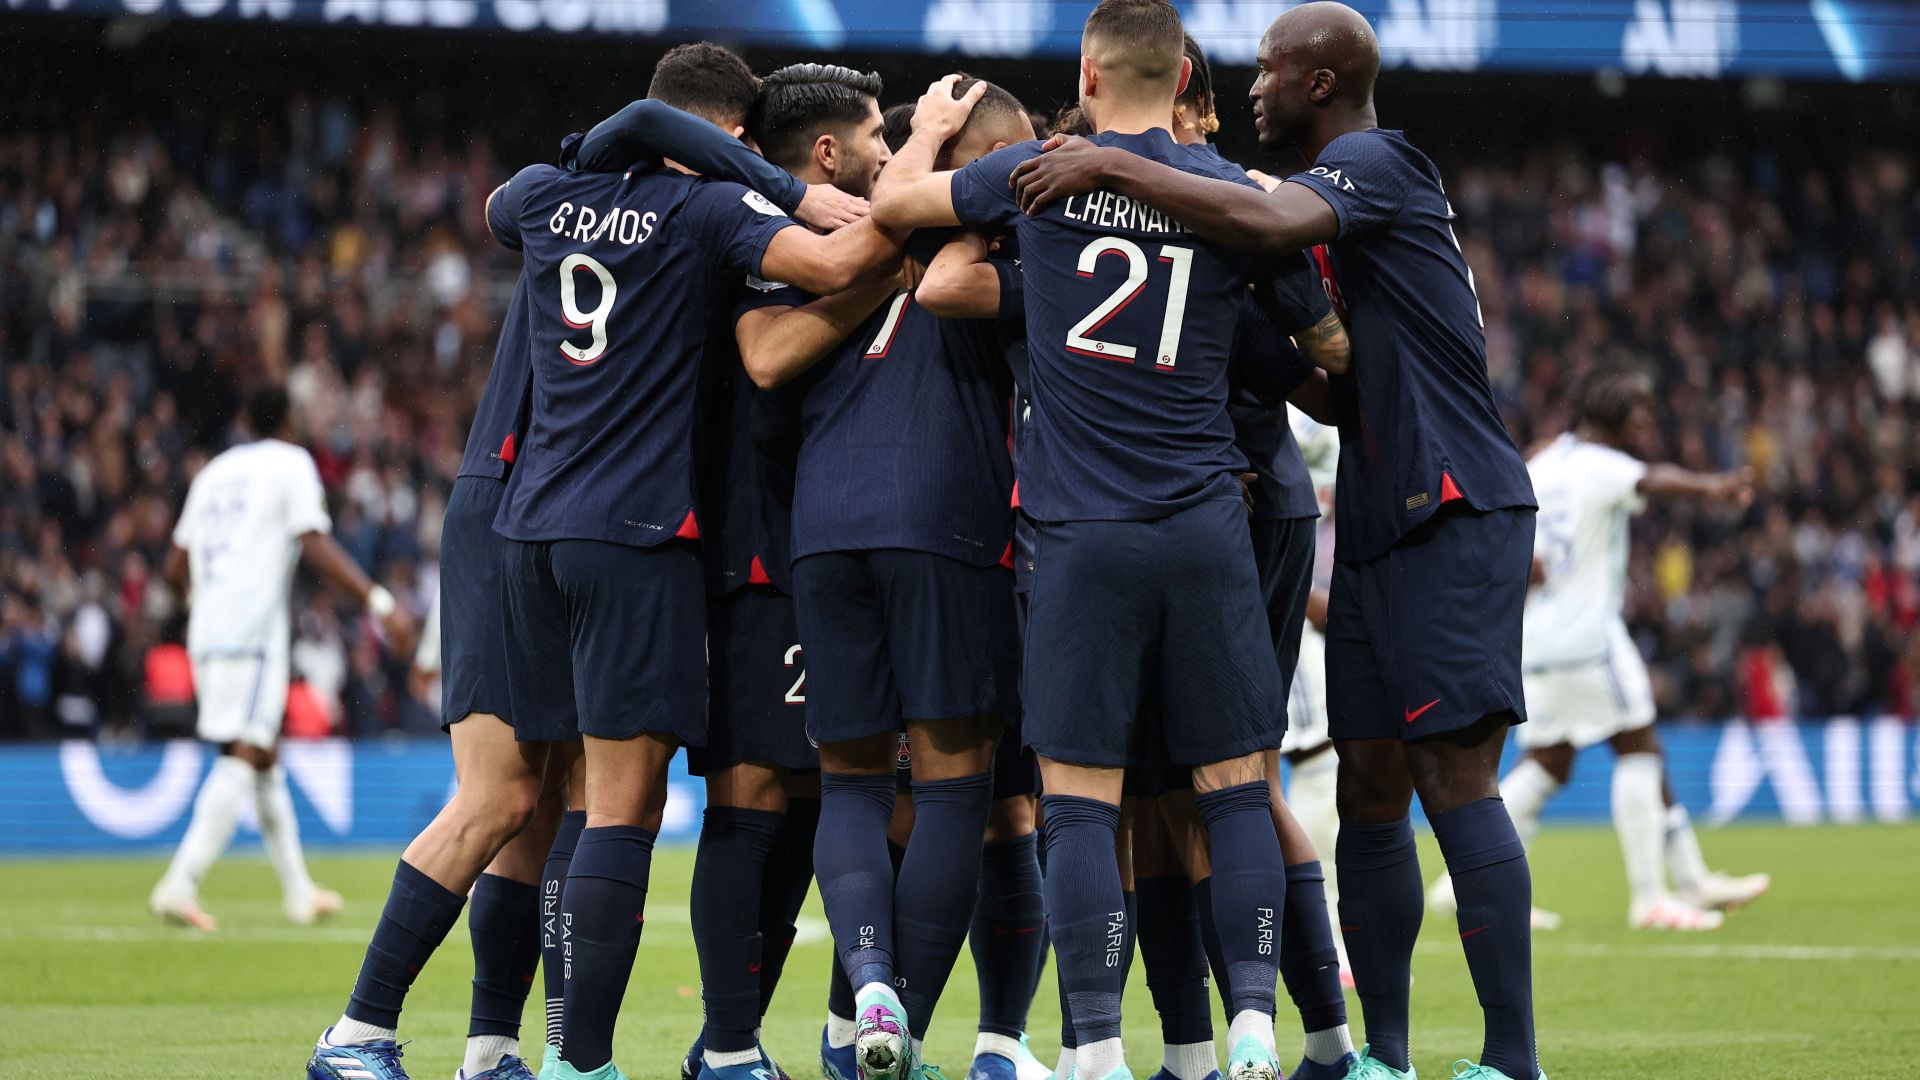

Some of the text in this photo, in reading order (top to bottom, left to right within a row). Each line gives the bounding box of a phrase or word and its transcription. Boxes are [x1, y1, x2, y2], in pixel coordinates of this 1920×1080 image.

[1305, 166, 1356, 191] OAT
[559, 253, 617, 366] 9
[1065, 236, 1194, 371] 21
[783, 643, 806, 705] 2
[544, 879, 559, 948] PARIS
[562, 912, 573, 980] PARIS
[1105, 910, 1124, 968] PARIS
[1257, 907, 1273, 956] PARIS
